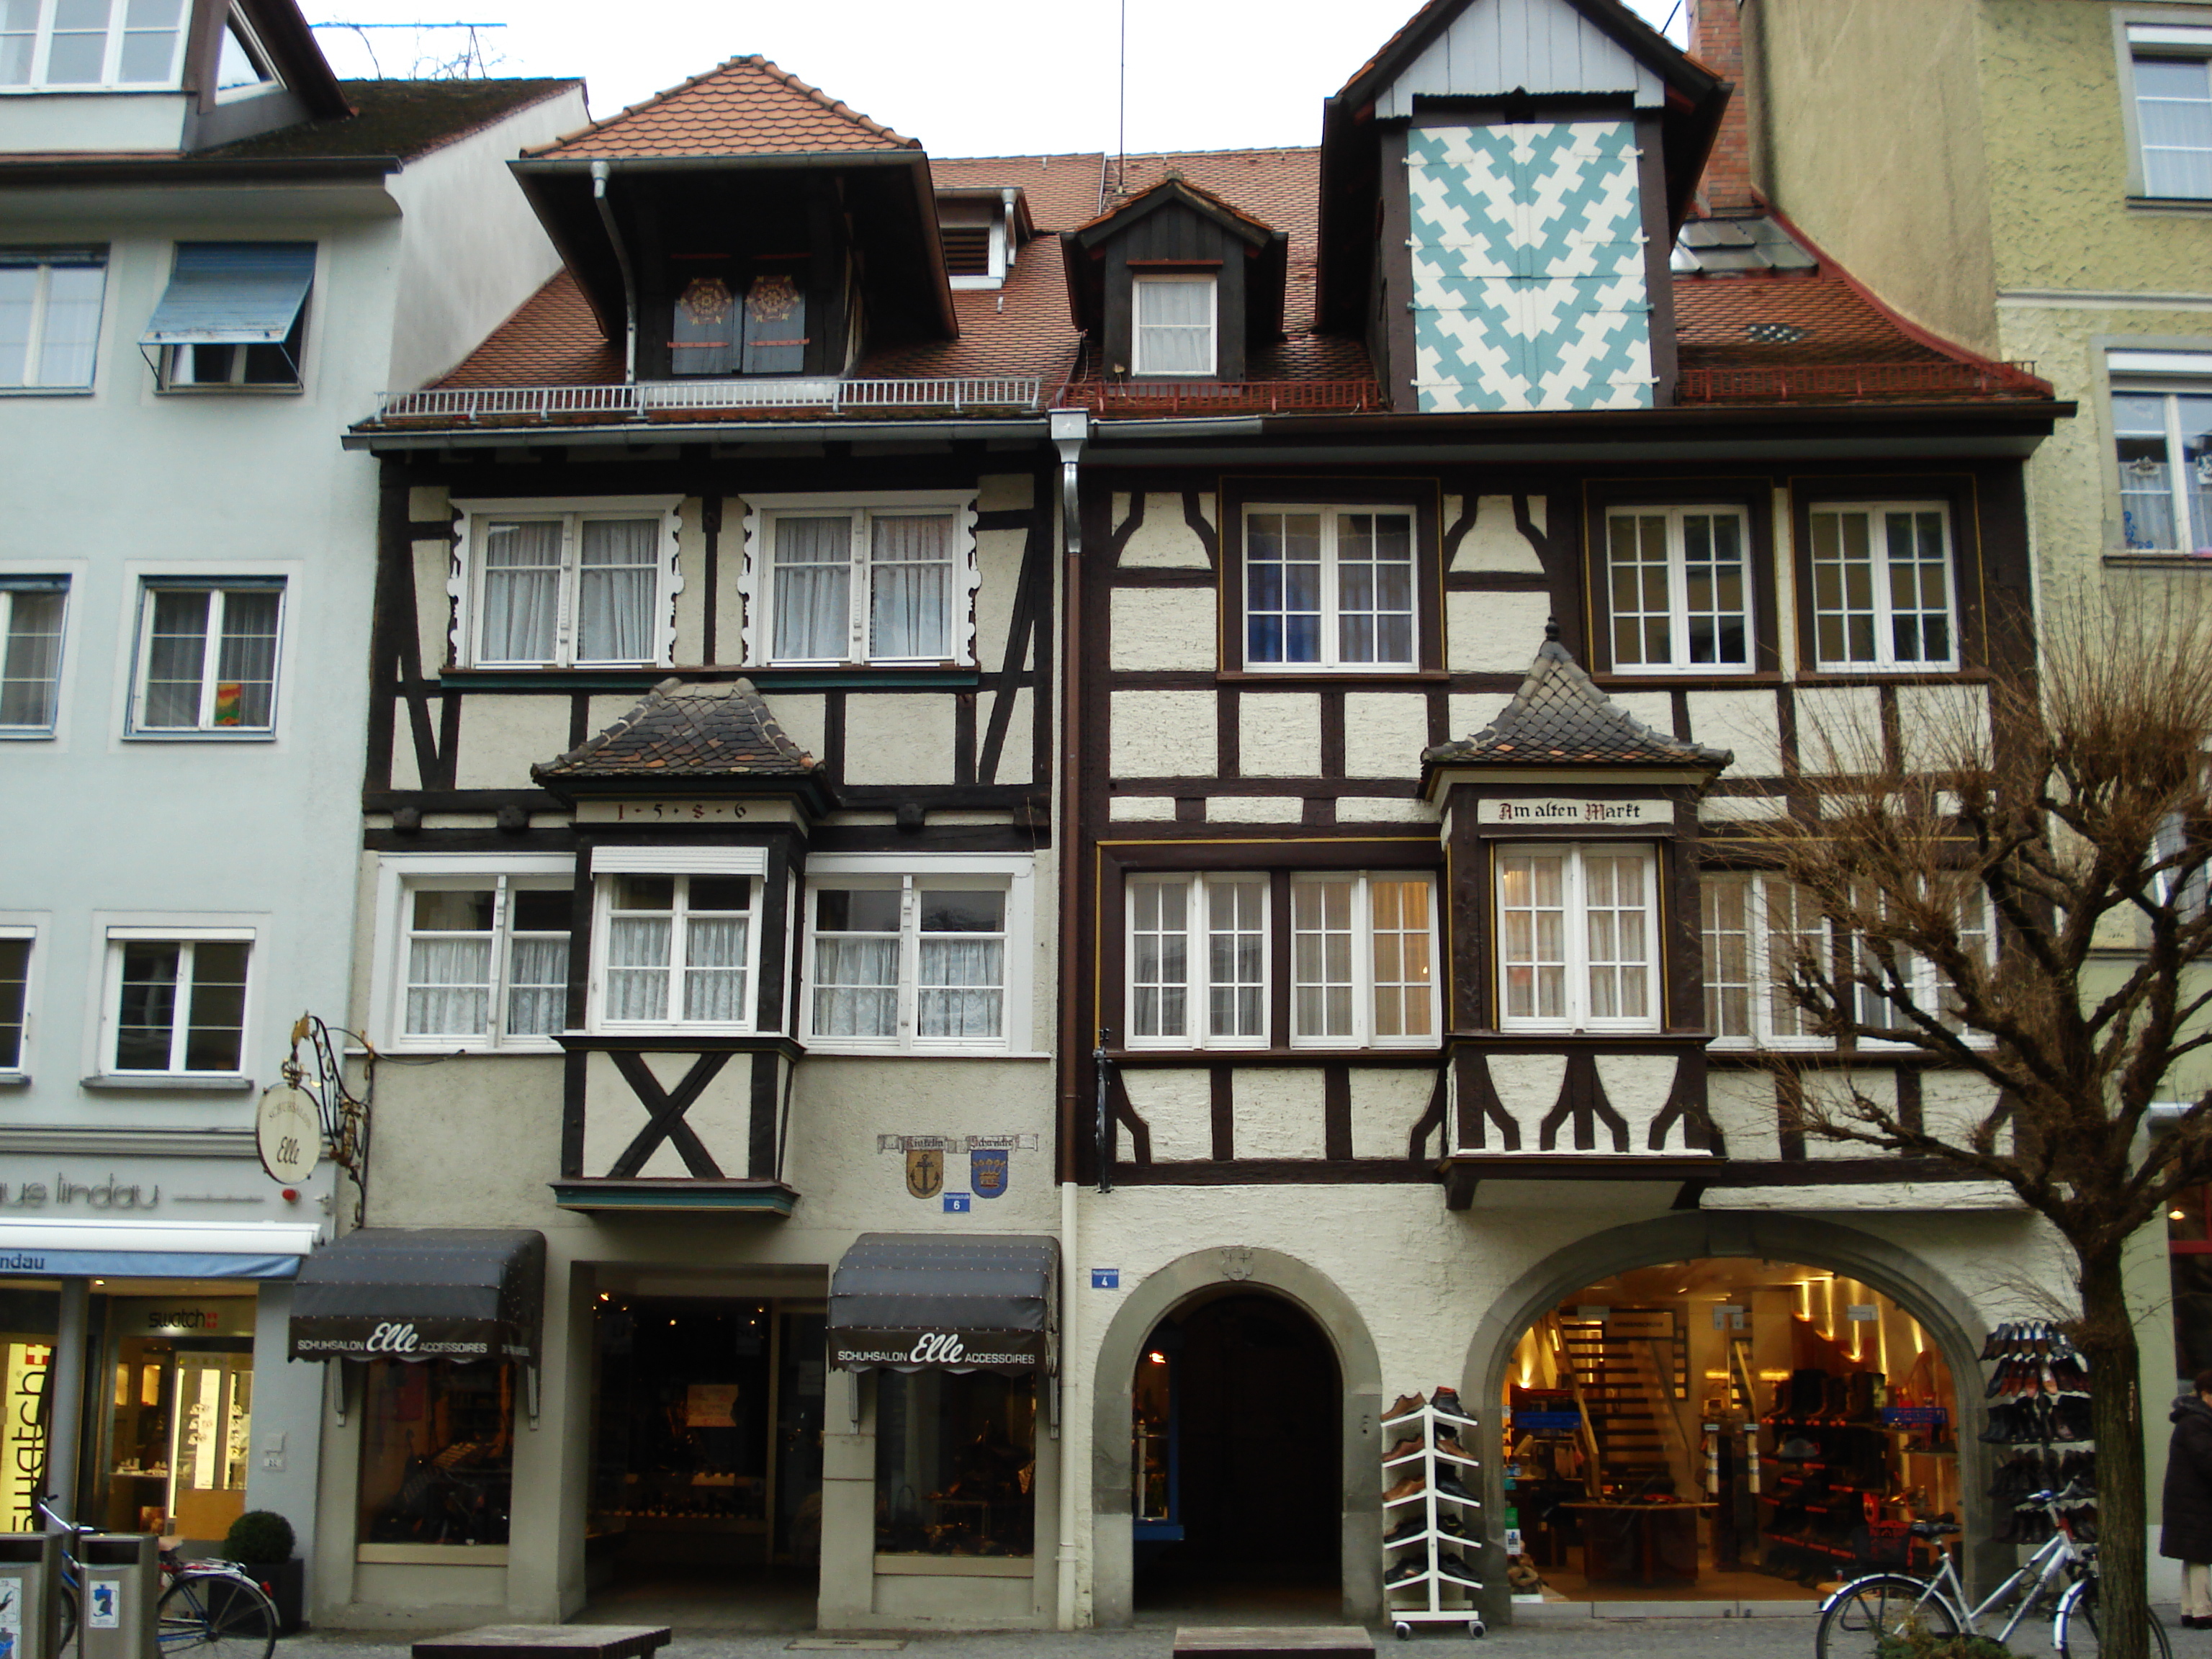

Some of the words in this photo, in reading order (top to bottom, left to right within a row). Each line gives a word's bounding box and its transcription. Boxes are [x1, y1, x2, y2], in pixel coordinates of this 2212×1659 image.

[1499, 803, 1530, 820] Am
[1535, 801, 1578, 817] alten
[1585, 803, 1641, 821] Markt
[276, 1136, 300, 1164] Elle
[57, 1172, 160, 1210] lindau
[953, 1200, 961, 1210] 6
[1102, 1275, 1108, 1287] 4
[148, 1308, 205, 1328] swatch
[297, 1339, 365, 1351] SCHUHSALON
[366, 1322, 419, 1353] Elle
[418, 1341, 488, 1354] ACCESSOIRES
[837, 1350, 908, 1362] SCHUHSALON
[909, 1332, 964, 1364] Elle
[964, 1353, 1035, 1365] ACCESSOIRES
